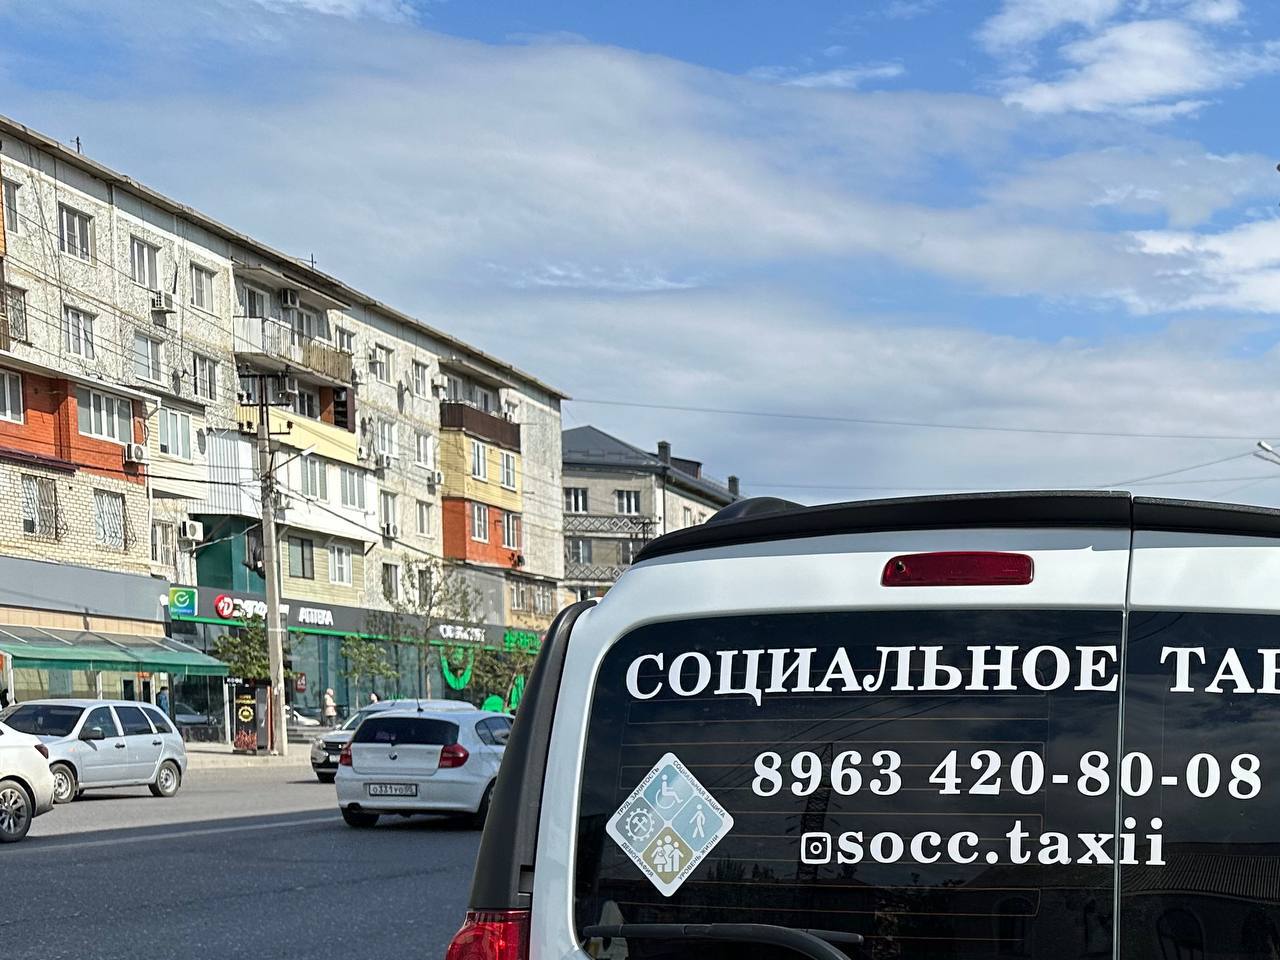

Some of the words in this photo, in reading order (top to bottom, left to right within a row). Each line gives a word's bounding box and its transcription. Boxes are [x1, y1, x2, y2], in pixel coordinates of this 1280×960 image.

[298, 607, 334, 626] АПТЕКА
[626, 645, 1119, 706] СОЦИАЛЬНОЕ
[631, 767, 660, 801] ЗАНЯТОСТЬ
[672, 760, 706, 797] СОЦИАЛЬНАЯ
[704, 794, 726, 818] ЗАЩИТА
[752, 750, 903, 797] 8963
[929, 750, 1262, 799] 420-80-08
[621, 841, 654, 878] ДЕМОГРАФИЯ
[678, 854, 702, 881] УРОВЕНЬ
[700, 834, 720, 856] ЖИЗНИ
[836, 820, 1166, 866] socc.taxii
